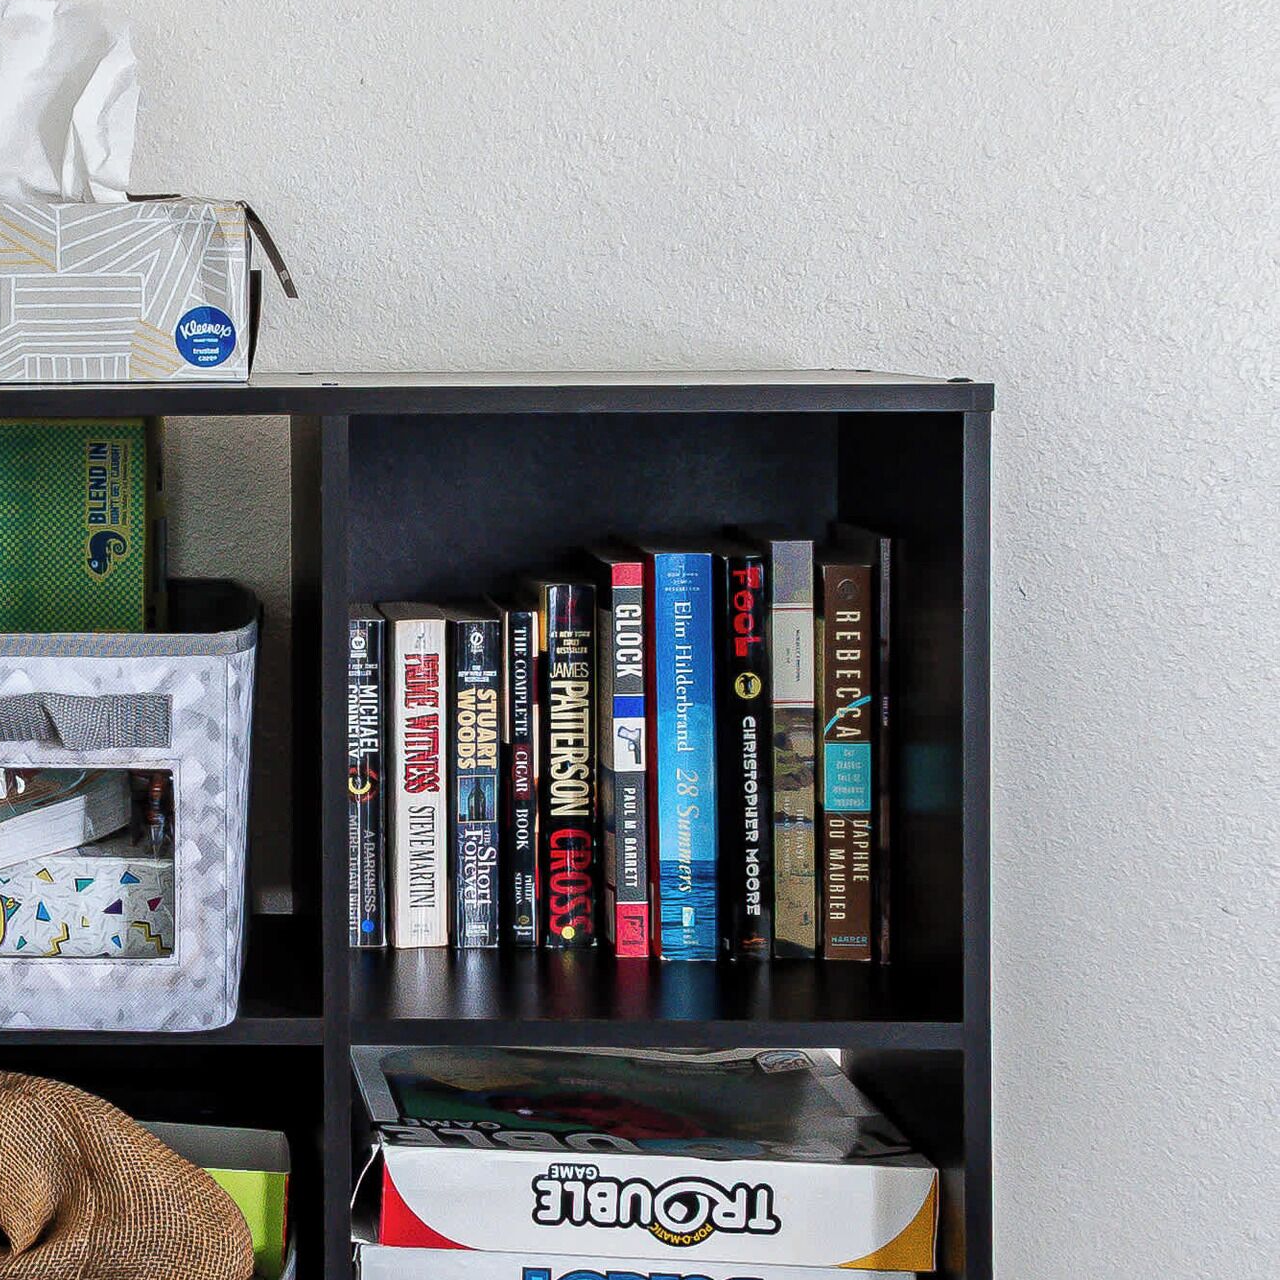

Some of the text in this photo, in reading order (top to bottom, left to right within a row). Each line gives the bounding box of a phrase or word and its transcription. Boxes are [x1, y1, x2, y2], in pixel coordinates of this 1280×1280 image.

[180, 320, 232, 339] Kleenex
[192, 347, 219, 355] trusted
[89, 442, 107, 524] BLEND IN
[615, 603, 644, 679] GLOCK
[673, 600, 693, 639] Elin
[732, 566, 761, 658] FOOL
[549, 662, 590, 679] JAMES
[675, 645, 695, 753] Hilderbrand
[835, 610, 862, 739] REBECCA
[359, 684, 379, 757] MICHAEL
[404, 713, 440, 793] WITNESS
[457, 688, 477, 770] WOODS
[476, 688, 498, 770] STUART
[514, 626, 530, 851] THE COMPLETE CIGAR BOOK
[550, 680, 590, 816] PATTERSON
[623, 787, 637, 821] PAUL
[675, 769, 700, 894] 28 Summers
[742, 715, 762, 917] CHRISTOPHER MOORE
[362, 842, 377, 914] DARKNESS
[408, 805, 436, 908] STEVE MARTINI
[464, 828, 483, 904] Forever
[477, 846, 498, 905] Short
[549, 827, 593, 936] CROSS
[624, 841, 638, 888] BARRETT
[829, 819, 846, 920] DU MAURIER
[852, 819, 870, 882] DAPHNE
[534, 1179, 778, 1234] TROUBLE
[551, 1164, 598, 1180] GAME
[649, 1221, 713, 1246] POP-O-MATIC
